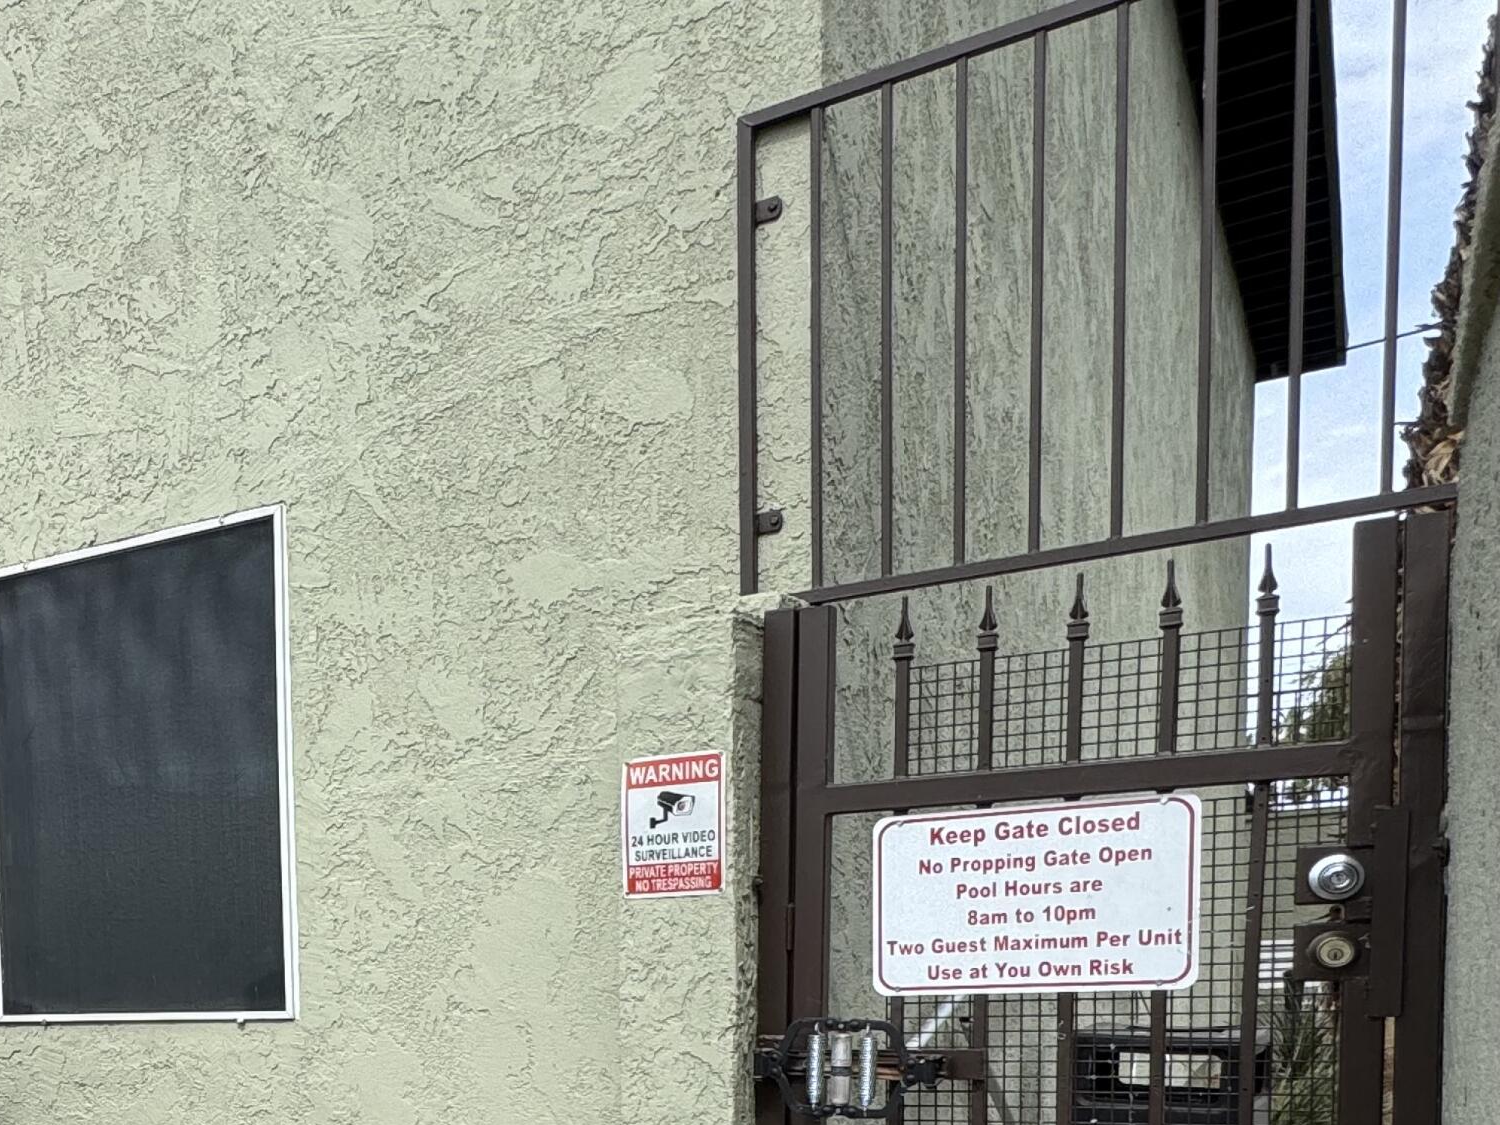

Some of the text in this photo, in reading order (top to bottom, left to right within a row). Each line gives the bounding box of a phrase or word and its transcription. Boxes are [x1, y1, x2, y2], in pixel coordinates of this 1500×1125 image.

[629, 758, 719, 785] WARNING
[631, 830, 715, 847] 24 HOUR VIDEO
[929, 811, 1140, 846] Keep Gate Closed
[635, 845, 712, 862] SURVEILLANCE
[918, 847, 1152, 874] No Propping Gate Open
[629, 862, 718, 879] PRIVATE PROPERTY
[636, 877, 712, 892] NO TRESPASSING
[956, 877, 1103, 899] Pool Hours are
[967, 906, 1096, 925] 8am to 10pm
[887, 928, 1182, 955] Two Guest Maximum Per Unit
[927, 959, 1133, 980] Use at You Own Risk
